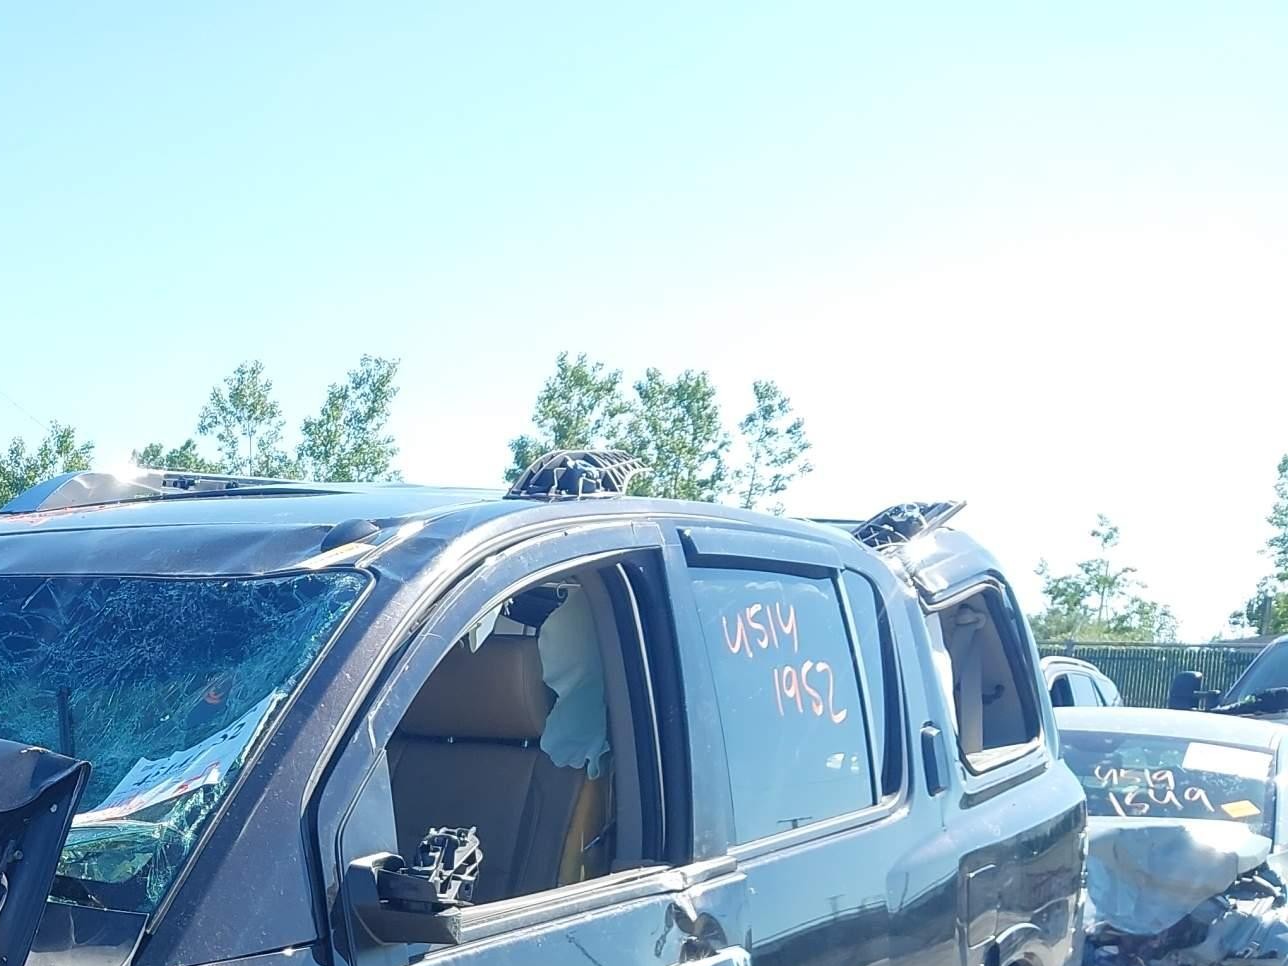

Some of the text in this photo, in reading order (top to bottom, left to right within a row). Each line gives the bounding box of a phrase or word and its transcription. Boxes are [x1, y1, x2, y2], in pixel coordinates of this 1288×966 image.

[721, 601, 798, 658] 4514
[773, 659, 847, 724] 1952
[1108, 785, 1215, 817] 1549
